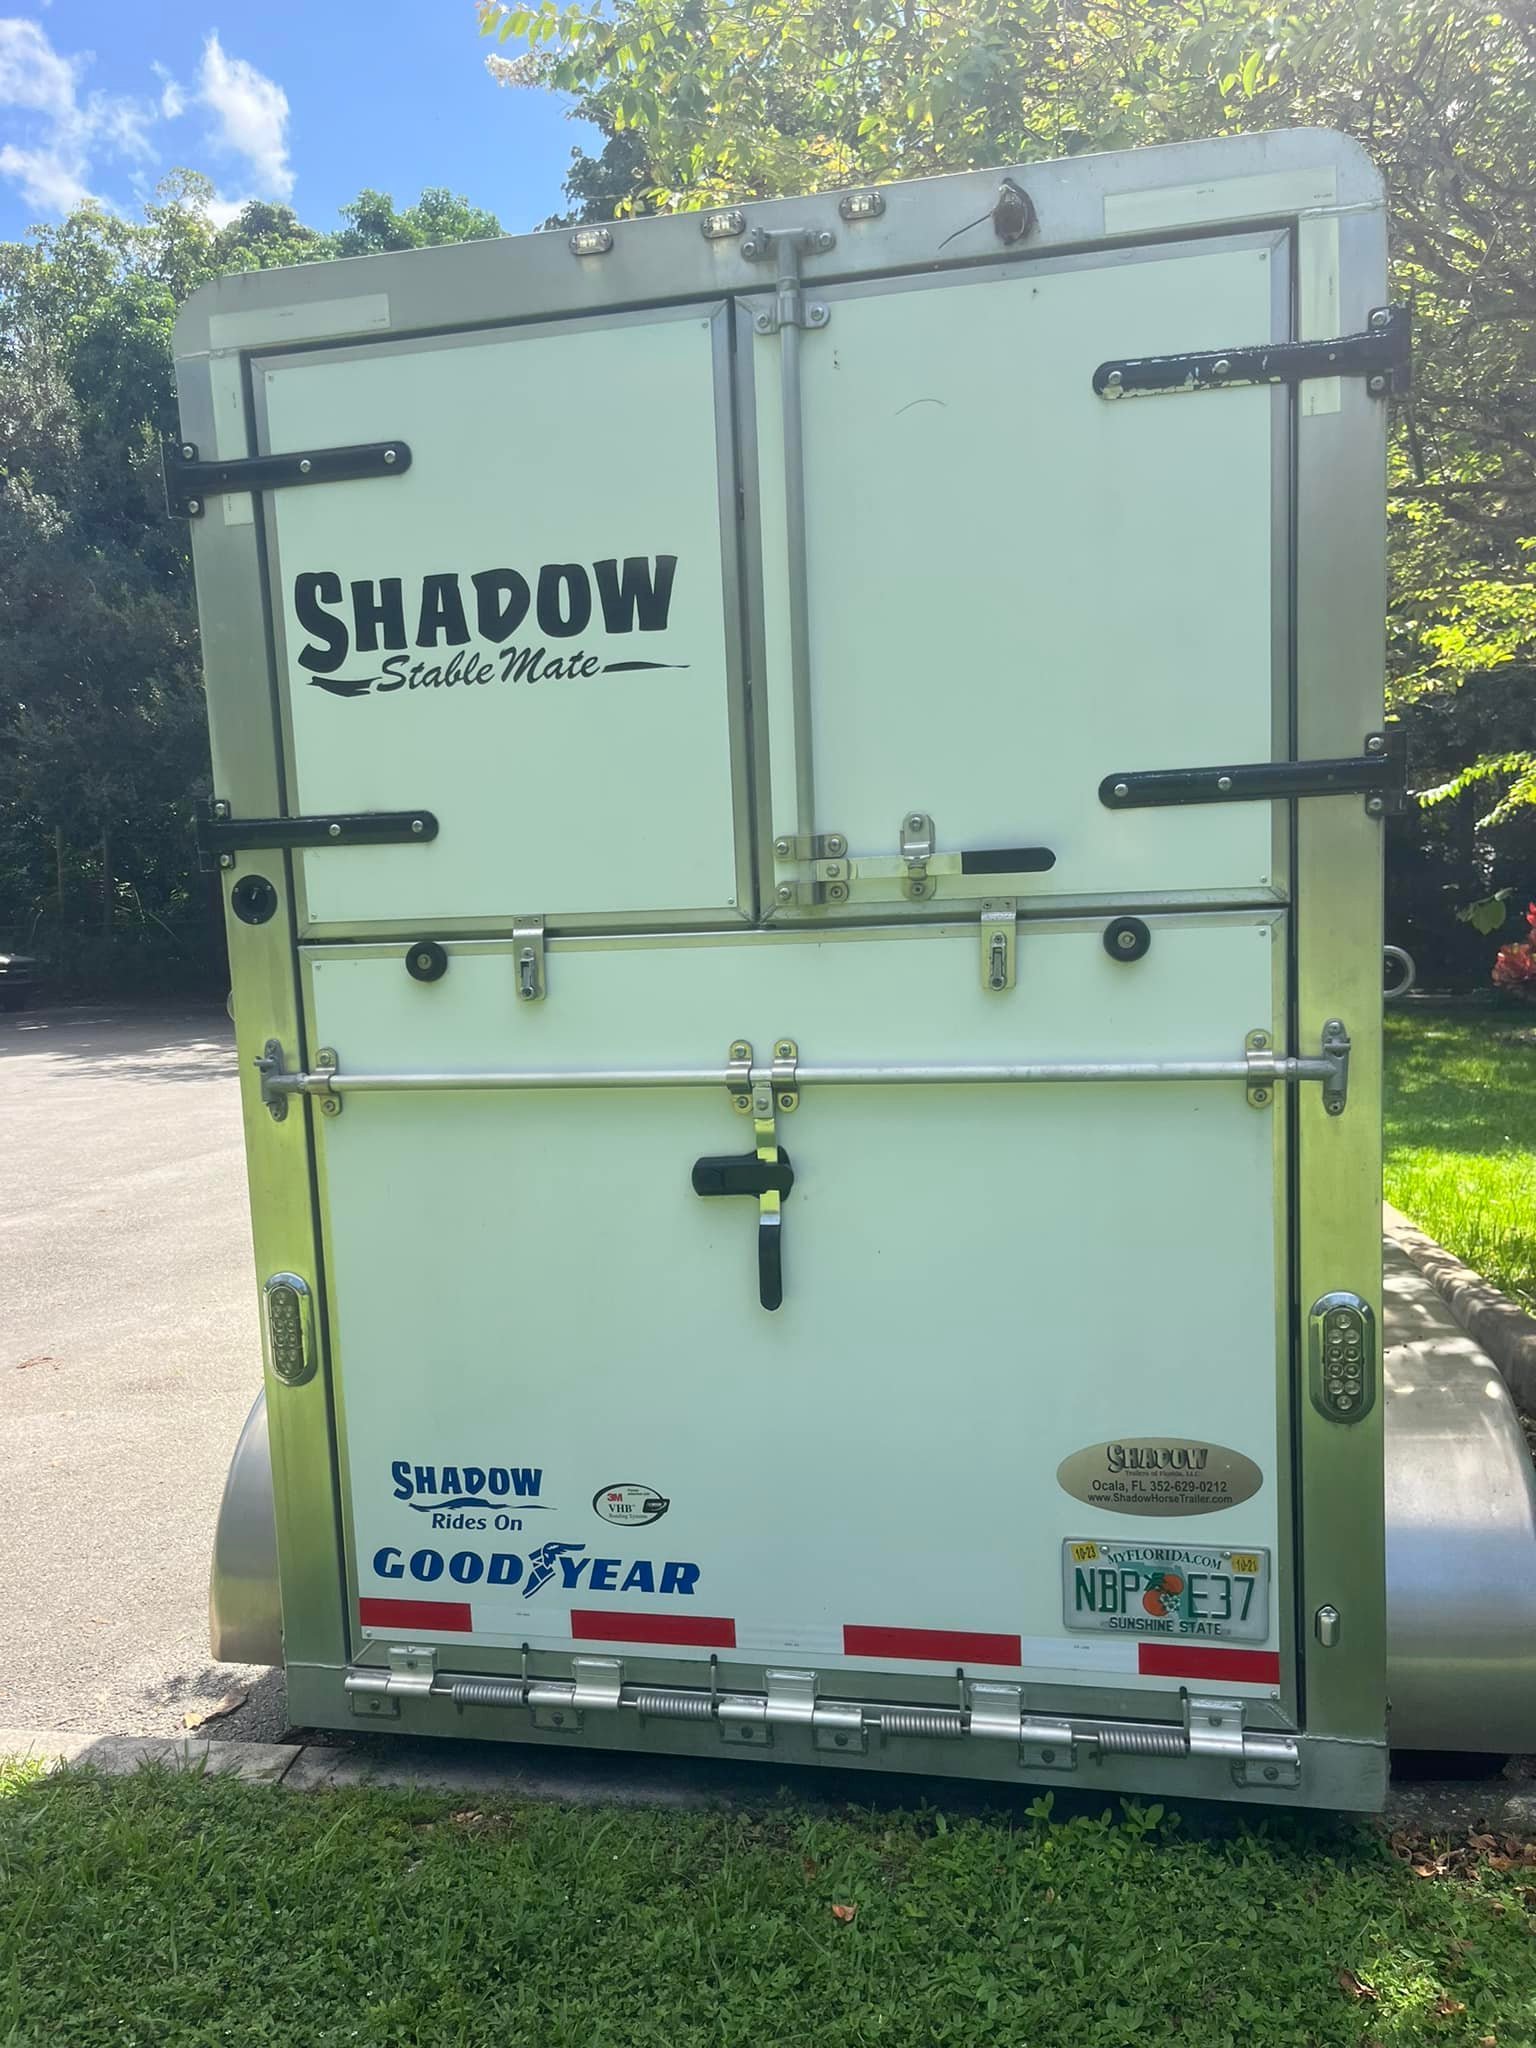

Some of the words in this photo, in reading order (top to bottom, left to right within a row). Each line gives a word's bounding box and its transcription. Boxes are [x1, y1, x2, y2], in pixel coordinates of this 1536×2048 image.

[295, 555, 678, 674] SHADOW
[376, 649, 496, 692] Stable
[499, 646, 601, 684] Mate
[1107, 1444, 1208, 1473] SHADOW
[391, 1461, 543, 1500] SHADOW
[1092, 1480, 1128, 1493] Ocala,
[1132, 1480, 1146, 1492] FL
[1150, 1480, 1227, 1493] 352-629-0212
[607, 1493, 623, 1502] 3M
[1088, 1493, 1233, 1504] www.ShadowHorseTrailer.com
[432, 1513, 487, 1531] Rides
[495, 1514, 523, 1531] On
[1109, 1616, 1174, 1632] SUNSHINE
[1180, 1620, 1222, 1636] STATE
